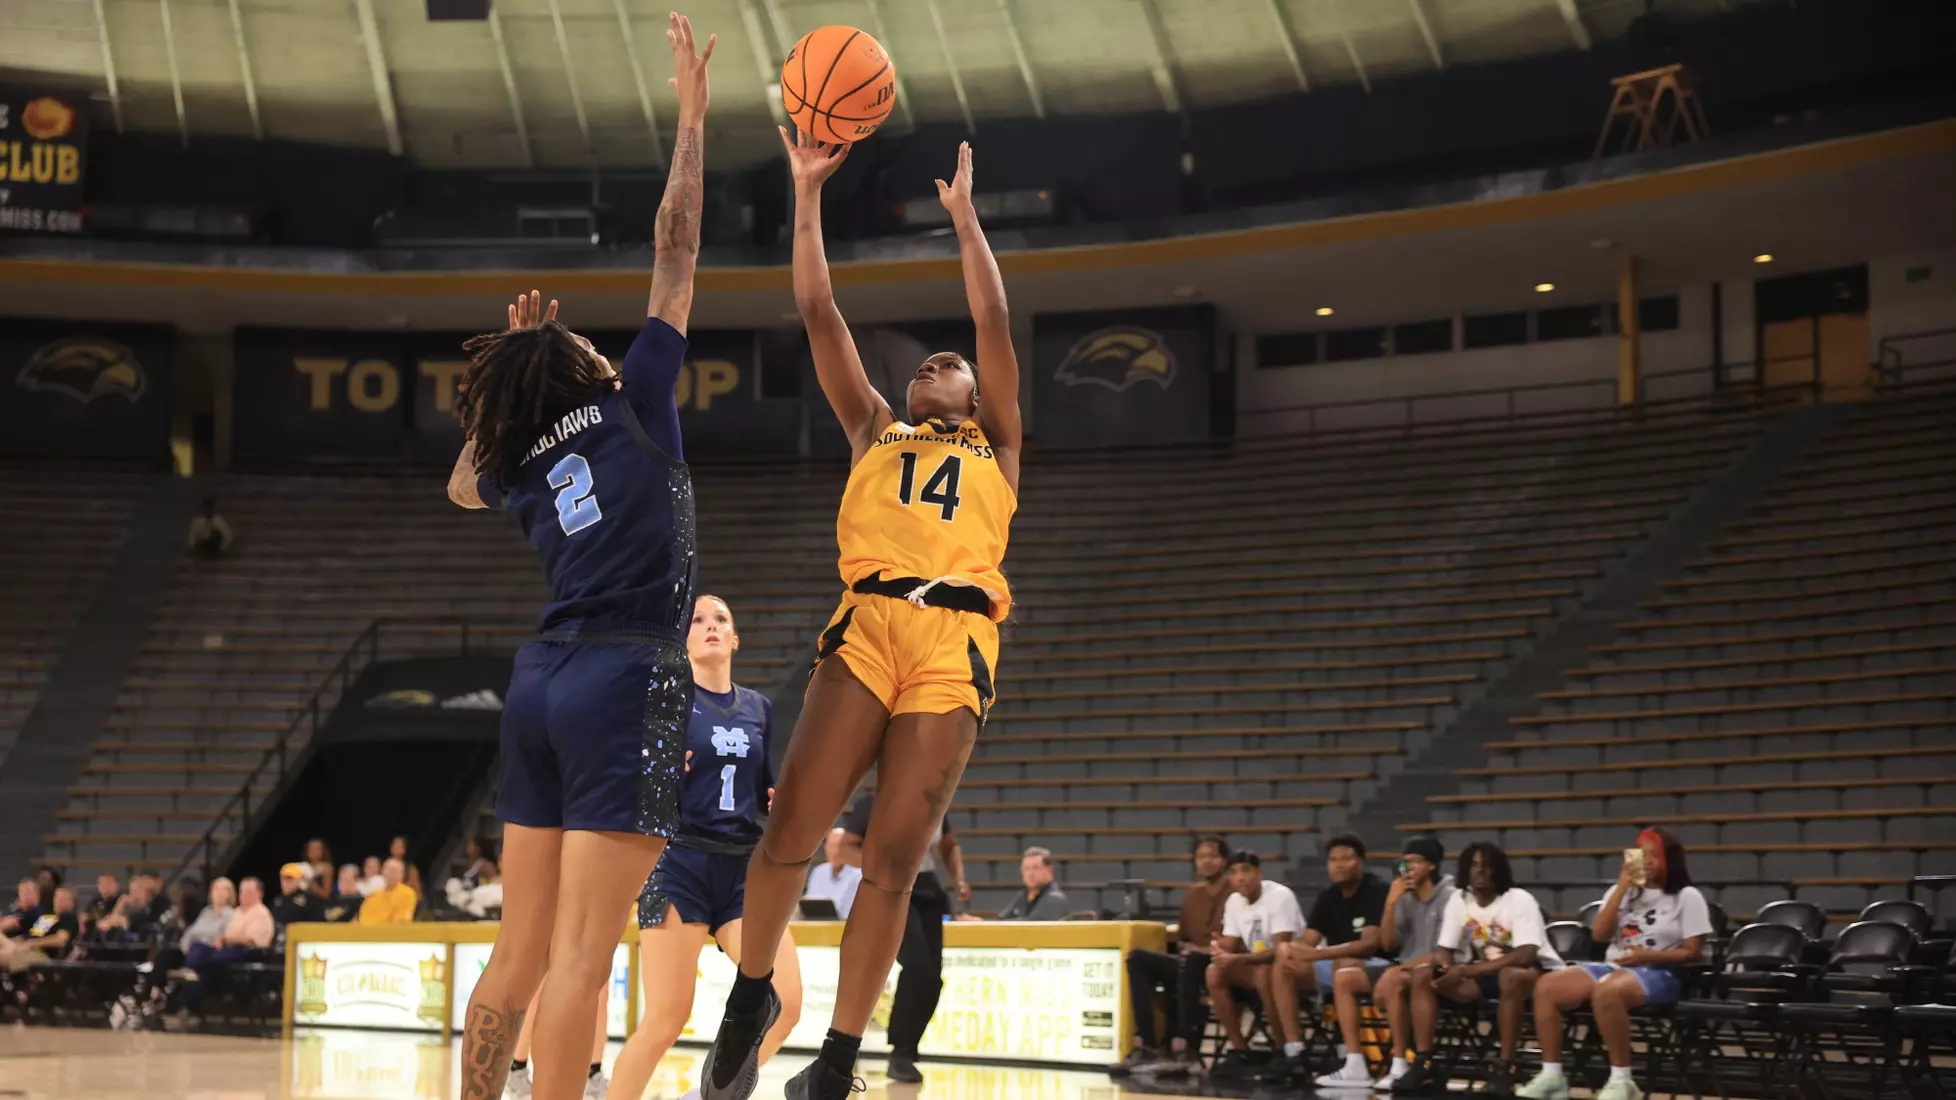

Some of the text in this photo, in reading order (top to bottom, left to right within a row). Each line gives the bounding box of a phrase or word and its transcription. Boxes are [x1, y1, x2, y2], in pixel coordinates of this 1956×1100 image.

[293, 357, 402, 413] TO
[547, 452, 603, 536] 2
[898, 452, 961, 521] 14
[719, 764, 737, 811] 1
[1018, 1013, 1071, 1055] APP
